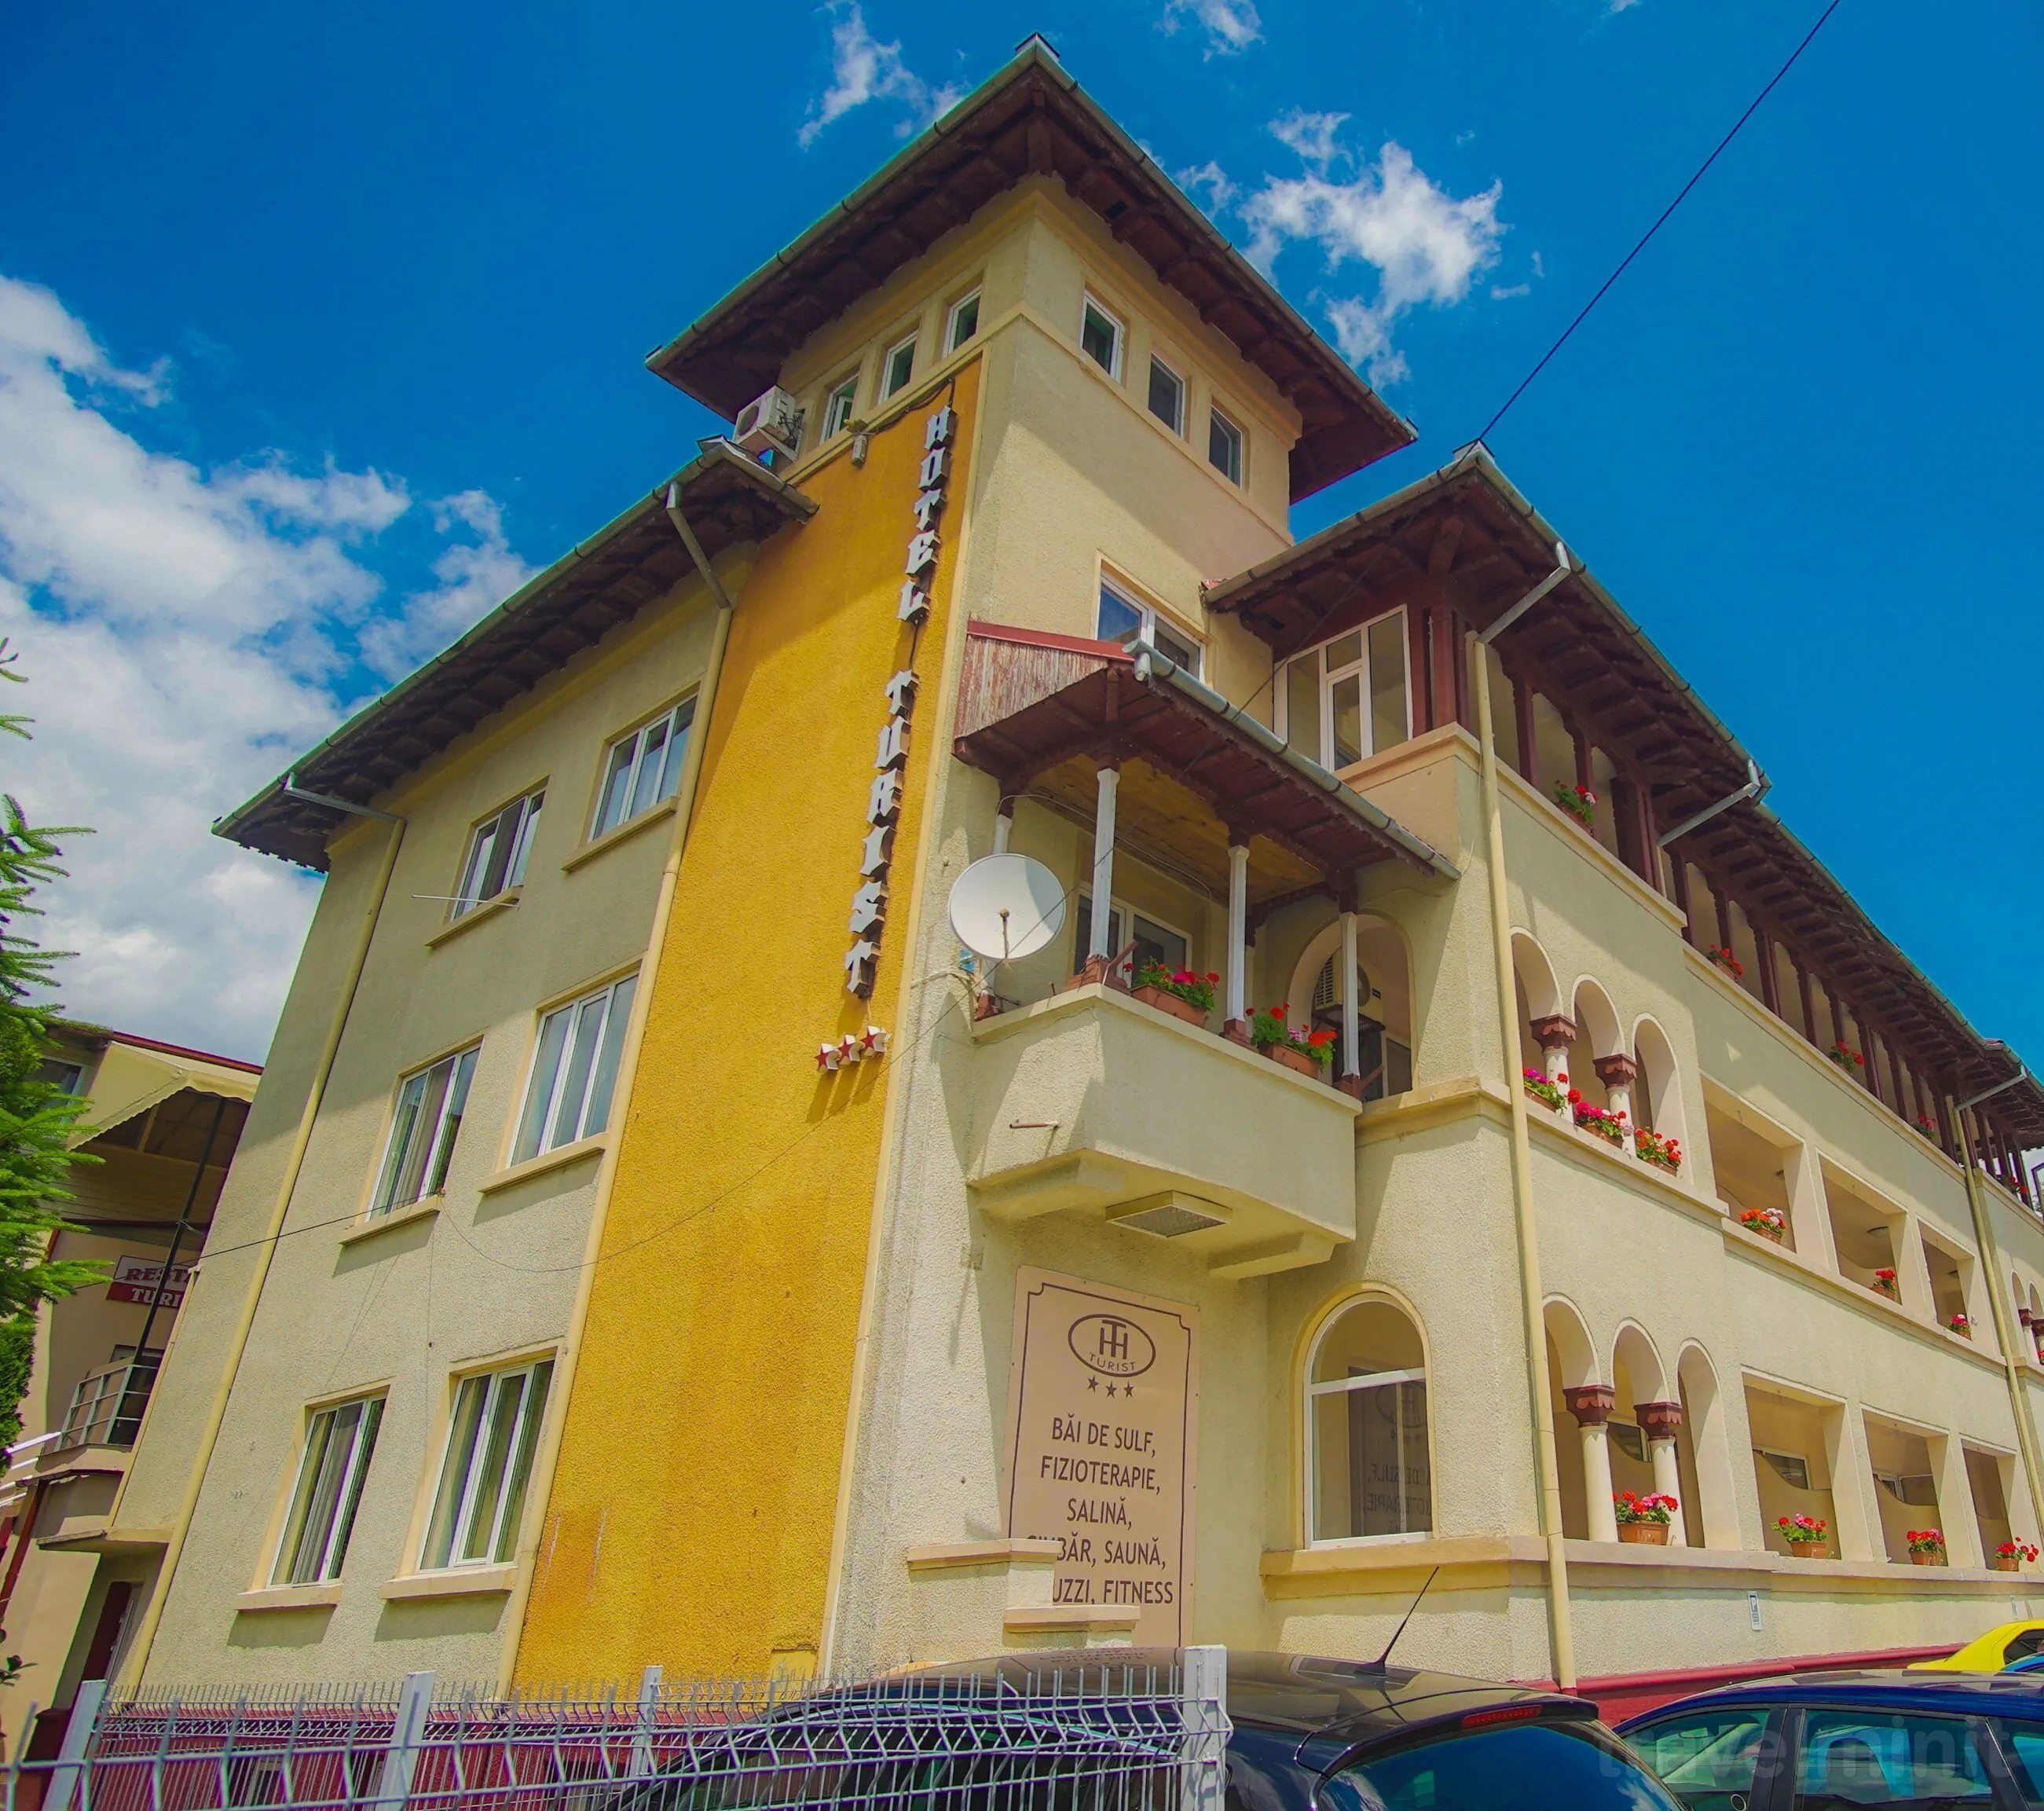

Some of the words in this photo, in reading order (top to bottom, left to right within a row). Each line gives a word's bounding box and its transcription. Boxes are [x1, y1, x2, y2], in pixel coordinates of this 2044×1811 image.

[897, 405, 953, 623] HOTEL
[845, 670, 915, 994] TURIST
[1090, 1351, 1136, 1372] TURIST
[1052, 1413, 1081, 1443] BĂI
[1087, 1422, 1109, 1447] DE
[1115, 1427, 1156, 1458] SULF,
[1041, 1455, 1160, 1495] FIZIOTERAPIE,
[1067, 1496, 1132, 1531] SALINĂ,
[1027, 1531, 1096, 1567] BĂR,
[1104, 1537, 1166, 1570] SAUNĂ,
[1103, 1580, 1174, 1604] FITNESS
